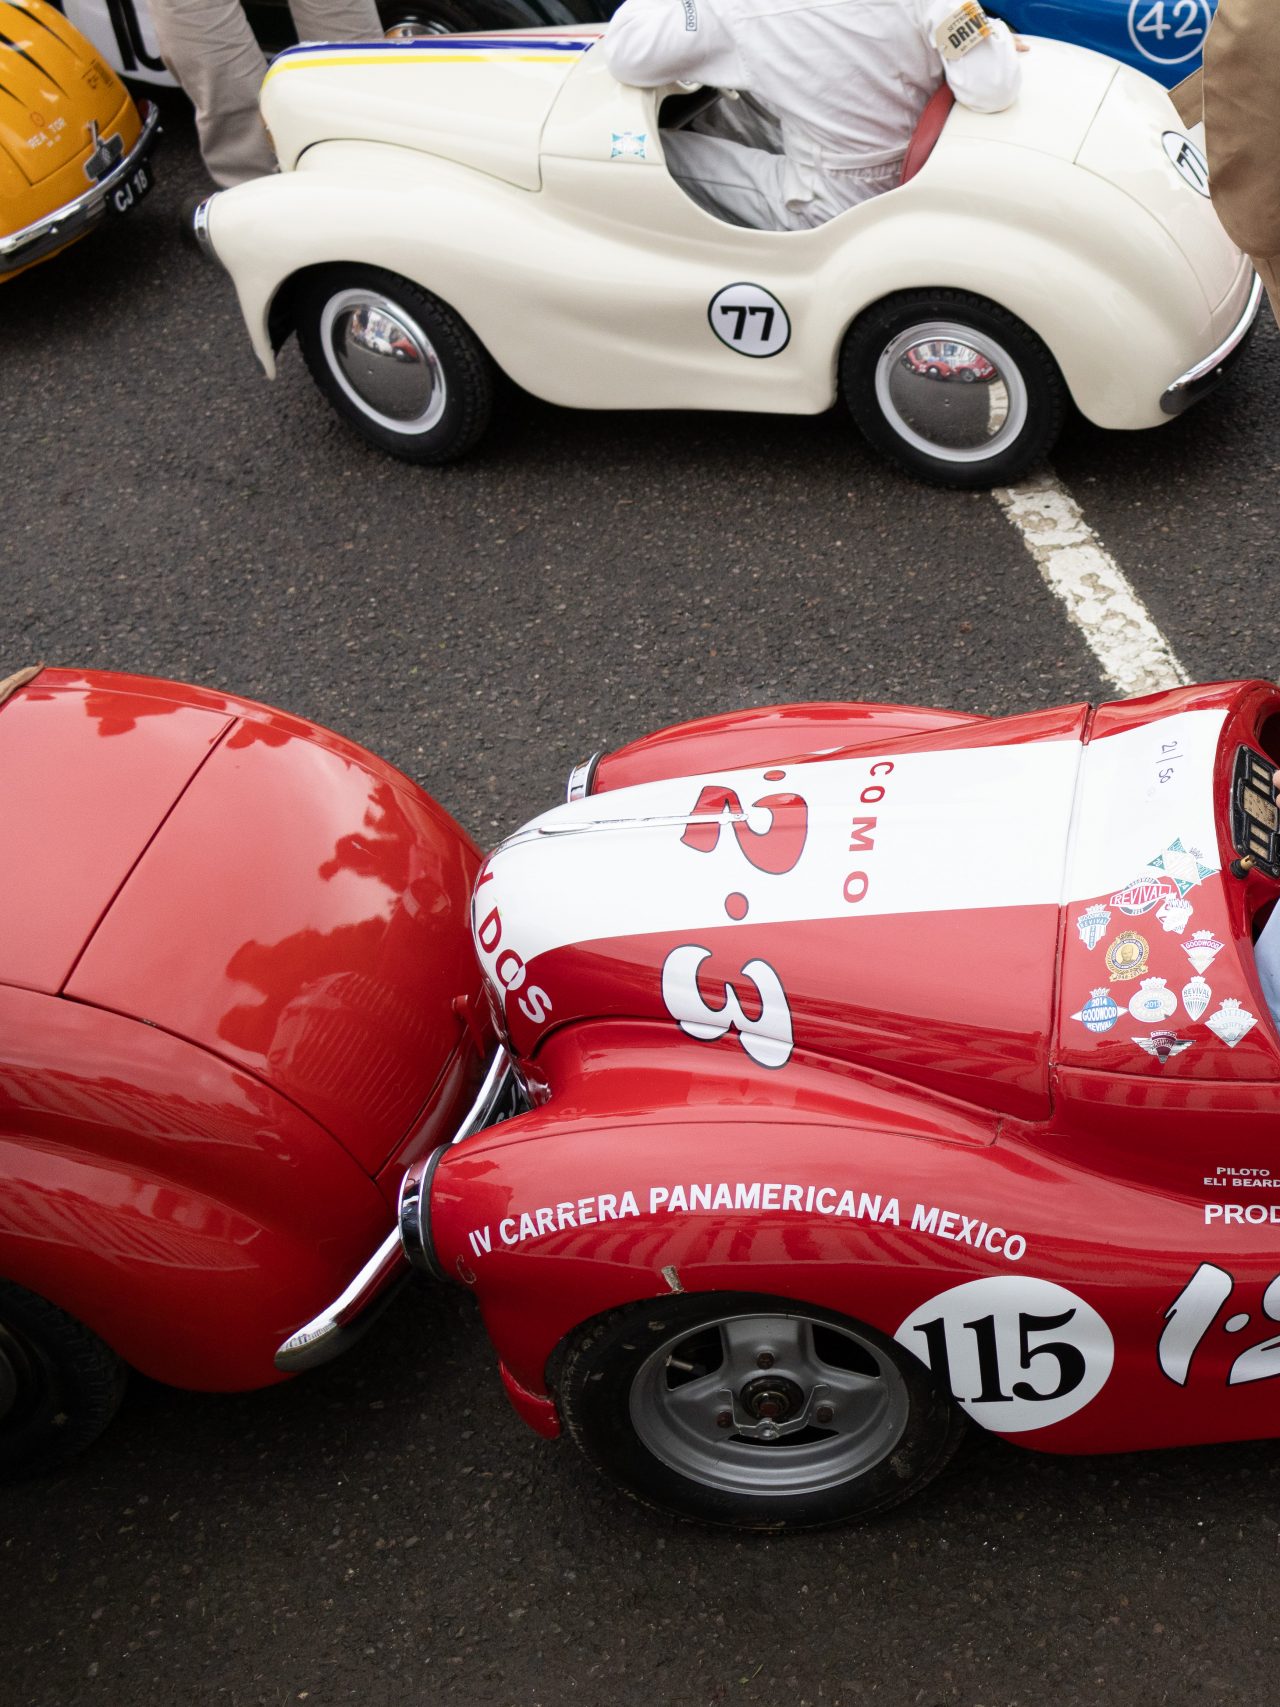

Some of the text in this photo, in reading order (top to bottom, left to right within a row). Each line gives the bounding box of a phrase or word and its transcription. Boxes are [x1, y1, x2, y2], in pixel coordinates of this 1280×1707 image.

[1136, 0, 1203, 40] 42
[720, 305, 775, 342] 77
[843, 761, 895, 904] COMO
[1113, 885, 1167, 905] REVIVAL
[1185, 940, 1220, 949] GOODWOOD
[1183, 988, 1210, 999] REVIVAL
[1091, 998, 1108, 1007] 2014
[1082, 1006, 1117, 1022] GOODWOOD
[1087, 1021, 1112, 1032] REVIVAL
[1216, 1167, 1271, 1177] PILOTO
[1203, 1177, 1227, 1187] ELI
[467, 1182, 1028, 1262] IV CARRERA PANAMERICANA MEXICO
[913, 1308, 1086, 1403] 115
